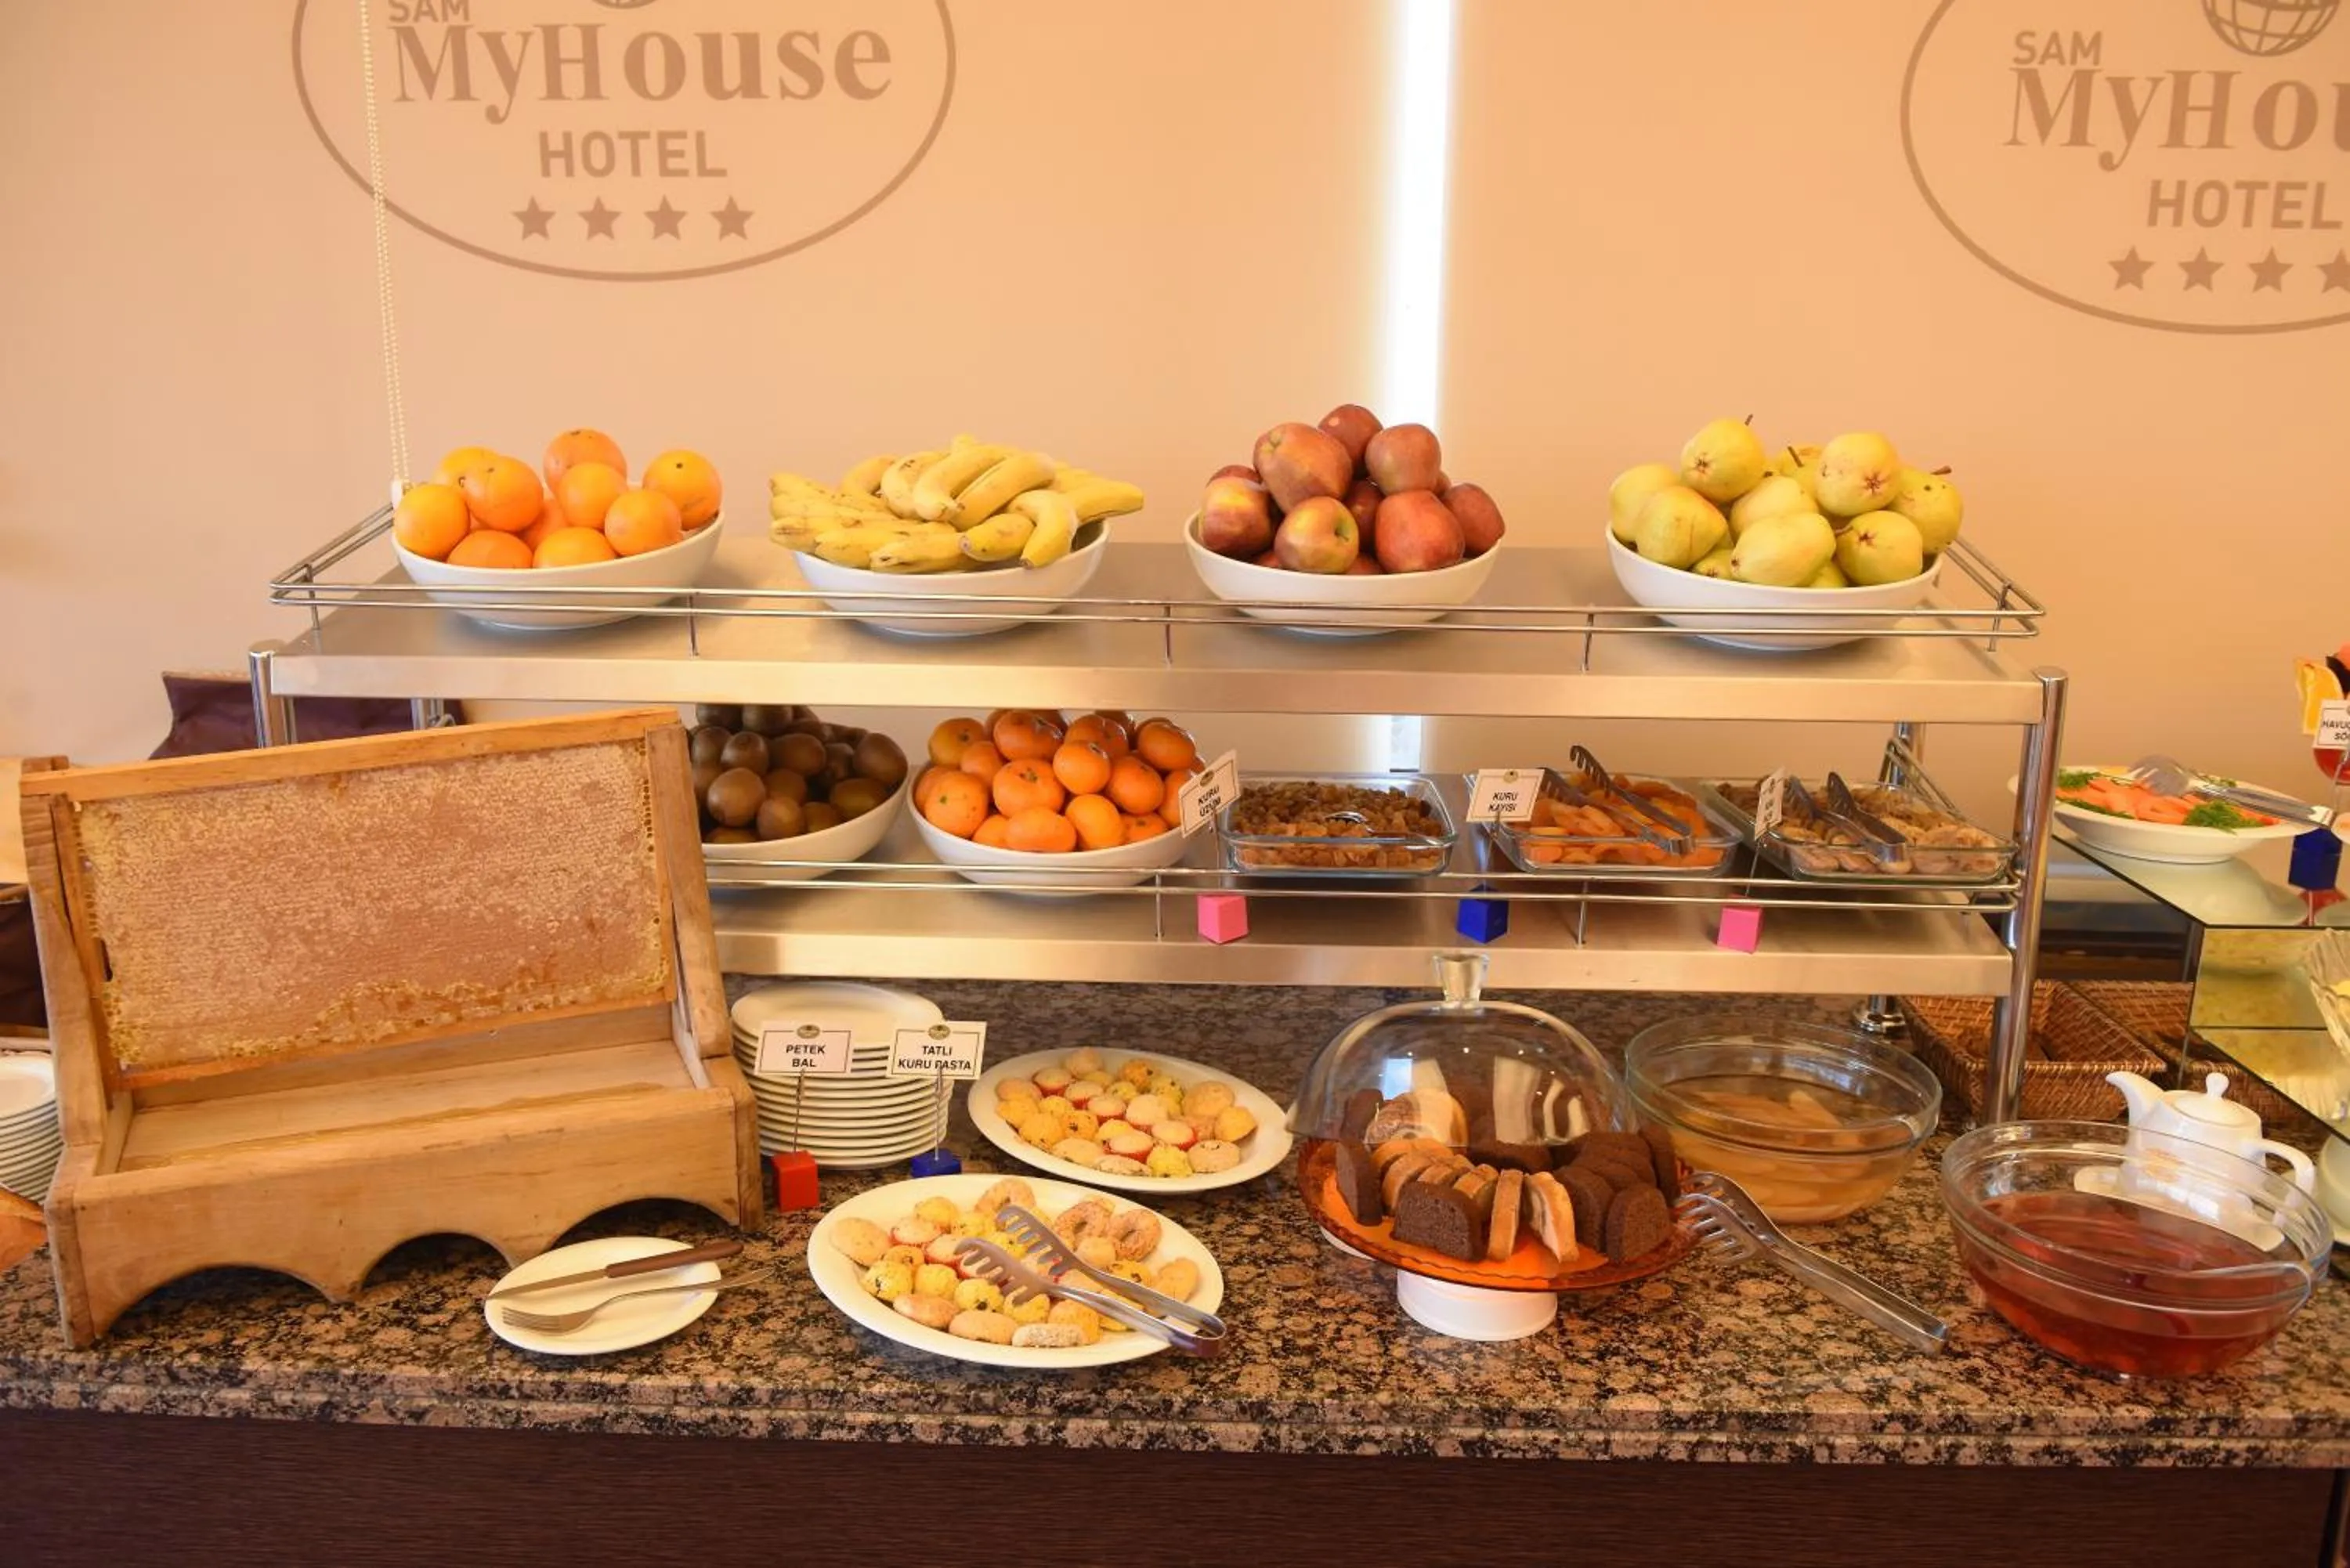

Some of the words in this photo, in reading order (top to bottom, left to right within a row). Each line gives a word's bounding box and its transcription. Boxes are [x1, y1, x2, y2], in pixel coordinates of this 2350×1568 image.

[389, 0, 470, 23] SAM
[2012, 30, 2102, 67] SAM
[388, 23, 891, 125] MyHouse
[2002, 67, 2350, 172] MyHo
[539, 130, 728, 179] HOTEL
[2147, 179, 2344, 230] HOTEL
[1493, 792, 1517, 800] KURU
[786, 1044, 826, 1055] PETEK
[922, 1045, 953, 1056] TATLI
[792, 1058, 816, 1068] BAL
[898, 1059, 931, 1070] KURU
[935, 1060, 971, 1071] PASTA
